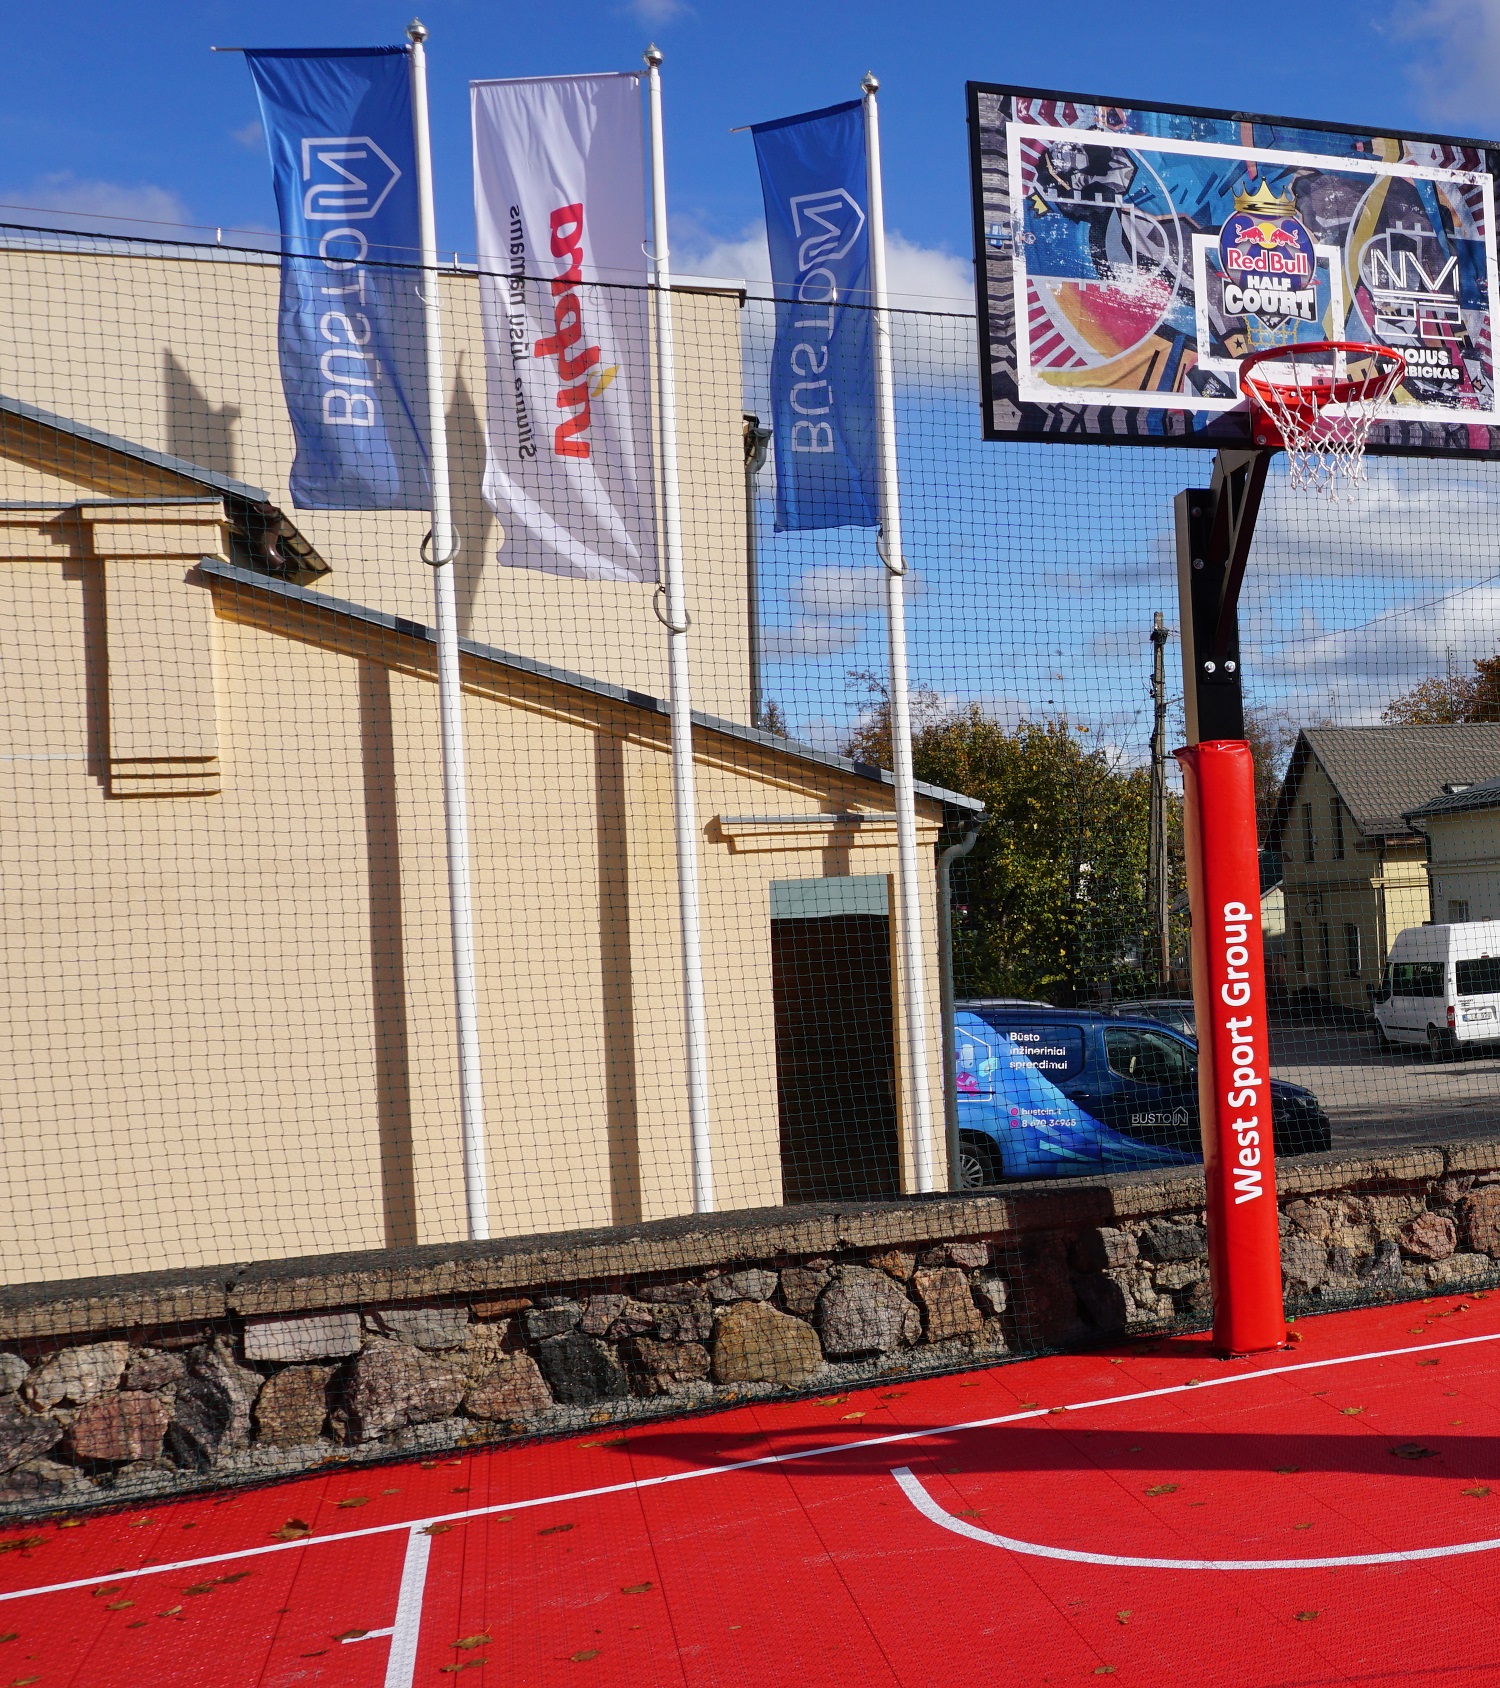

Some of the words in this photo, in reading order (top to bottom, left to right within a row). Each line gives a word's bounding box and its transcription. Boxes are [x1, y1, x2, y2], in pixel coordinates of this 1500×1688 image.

[1227, 248, 1268, 272] Red
[1269, 251, 1308, 275] Bull
[1247, 275, 1291, 291] HALF
[1225, 284, 1314, 319] COURT
[1222, 901, 1253, 1007] Group
[1010, 1032, 1040, 1042] Būsto
[1227, 1015, 1262, 1108] Sport
[1021, 1108, 1062, 1116] bustoin.t
[1021, 1119, 1028, 1127] 8
[1232, 1116, 1263, 1205] West
